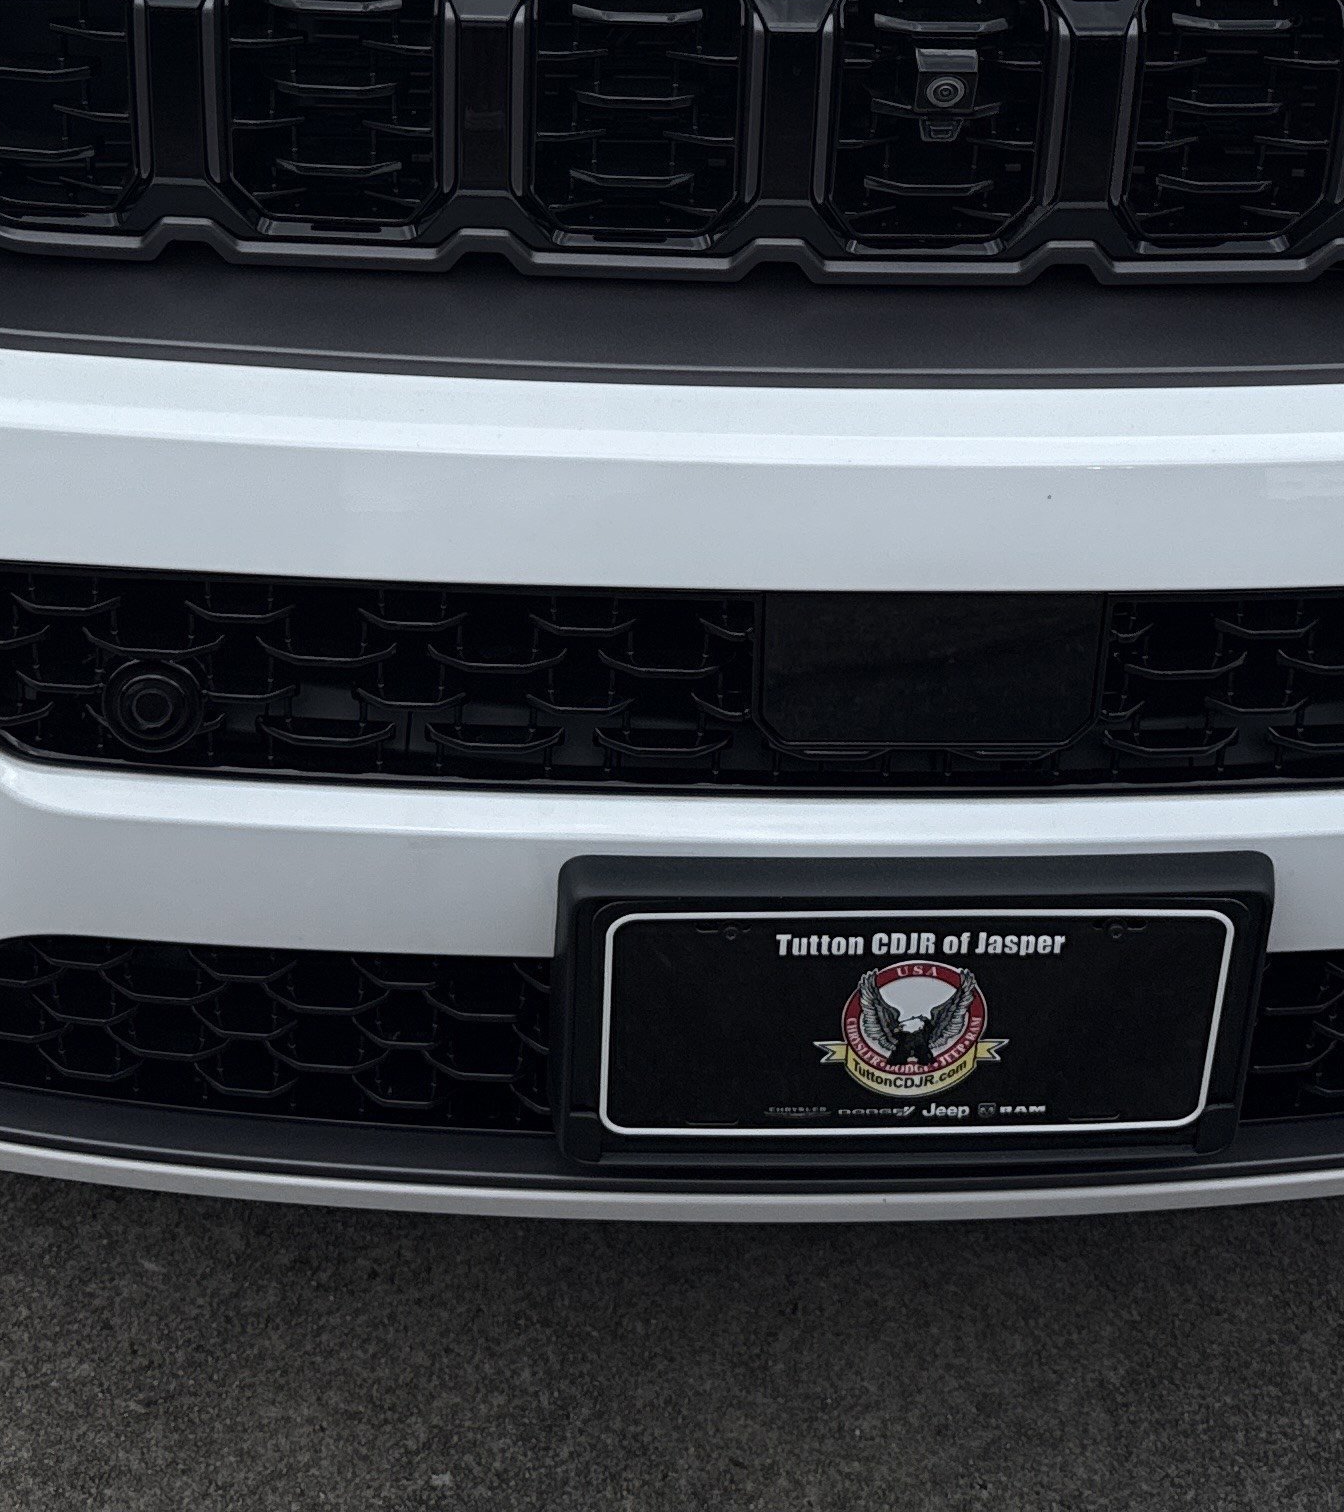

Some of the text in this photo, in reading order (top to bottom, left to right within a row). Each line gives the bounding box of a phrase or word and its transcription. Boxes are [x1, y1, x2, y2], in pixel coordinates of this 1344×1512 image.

[776, 931, 1066, 956] Tutton CDJR of Jasper
[896, 965, 938, 978] USA
[937, 1043, 967, 1067] JEEP
[967, 1016, 982, 1042] RAM
[852, 1058, 967, 1089] TuttonCDJR.com
[922, 1103, 970, 1118] Jeep
[999, 1105, 1046, 1114] RAM
